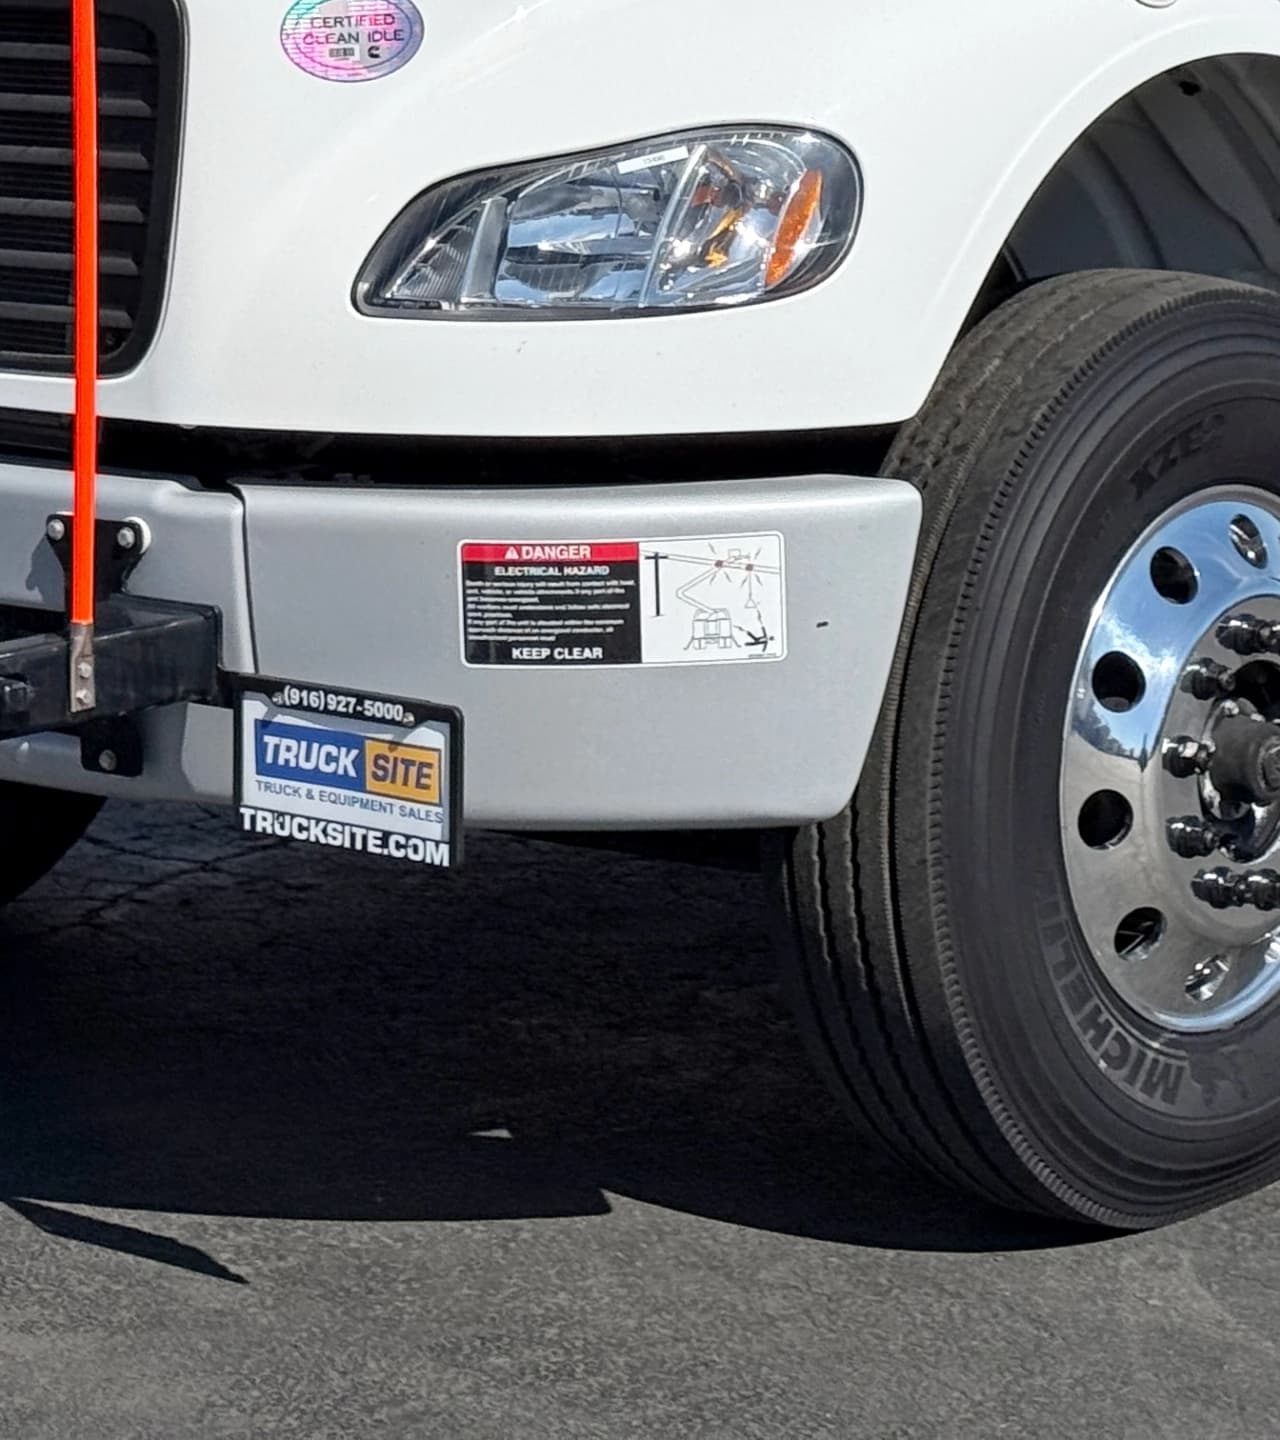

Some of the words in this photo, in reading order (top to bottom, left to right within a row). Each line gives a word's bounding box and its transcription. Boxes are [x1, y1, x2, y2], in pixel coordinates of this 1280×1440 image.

[311, 13, 396, 29] CERTIFIED
[303, 32, 360, 45] CLEAN
[368, 29, 405, 43] IDLE
[521, 545, 592, 560] DANGER
[494, 566, 562, 577] ELECTRICAL
[563, 565, 610, 576] HAZARD
[511, 647, 552, 660] KEEP
[553, 647, 604, 660] CLEAR
[263, 735, 360, 778] TRUCK
[371, 753, 434, 791] SITE
[255, 780, 302, 799] TRUCK
[305, 788, 315, 800] &
[319, 790, 395, 816] EQUIPMENT
[398, 805, 444, 824] SALES
[239, 807, 451, 867] TRUCKSITE.COM
